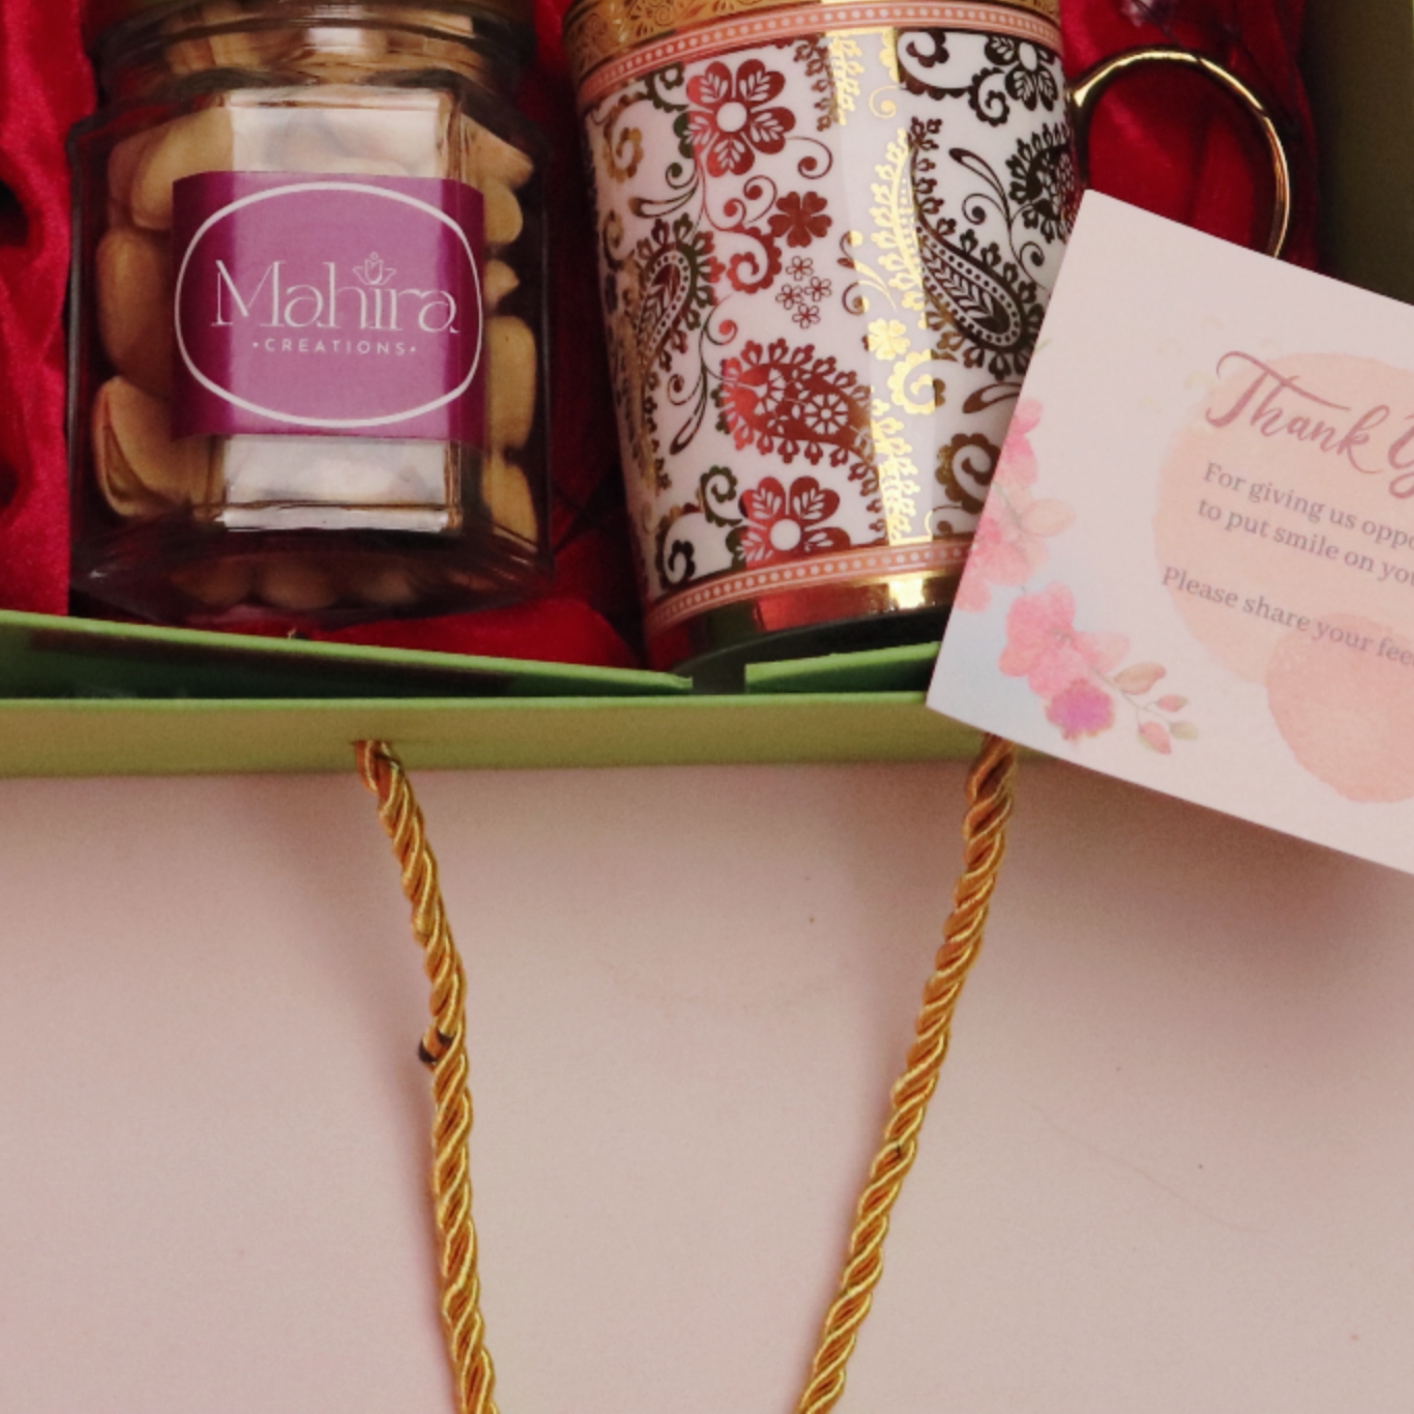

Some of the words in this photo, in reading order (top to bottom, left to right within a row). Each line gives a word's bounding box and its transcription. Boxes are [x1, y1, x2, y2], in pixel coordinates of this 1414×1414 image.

[210, 259, 460, 334] Mahira
[1204, 350, 1390, 475] Thank
[1203, 461, 1247, 492] For
[1248, 479, 1325, 523] giving
[1329, 509, 1356, 530] us
[1197, 498, 1222, 522] to
[1225, 508, 1270, 539] put
[1273, 522, 1341, 562] smile
[1344, 548, 1375, 573] on
[1161, 566, 1239, 608] Please
[1243, 592, 1311, 632] share
[1313, 619, 1374, 653] your
